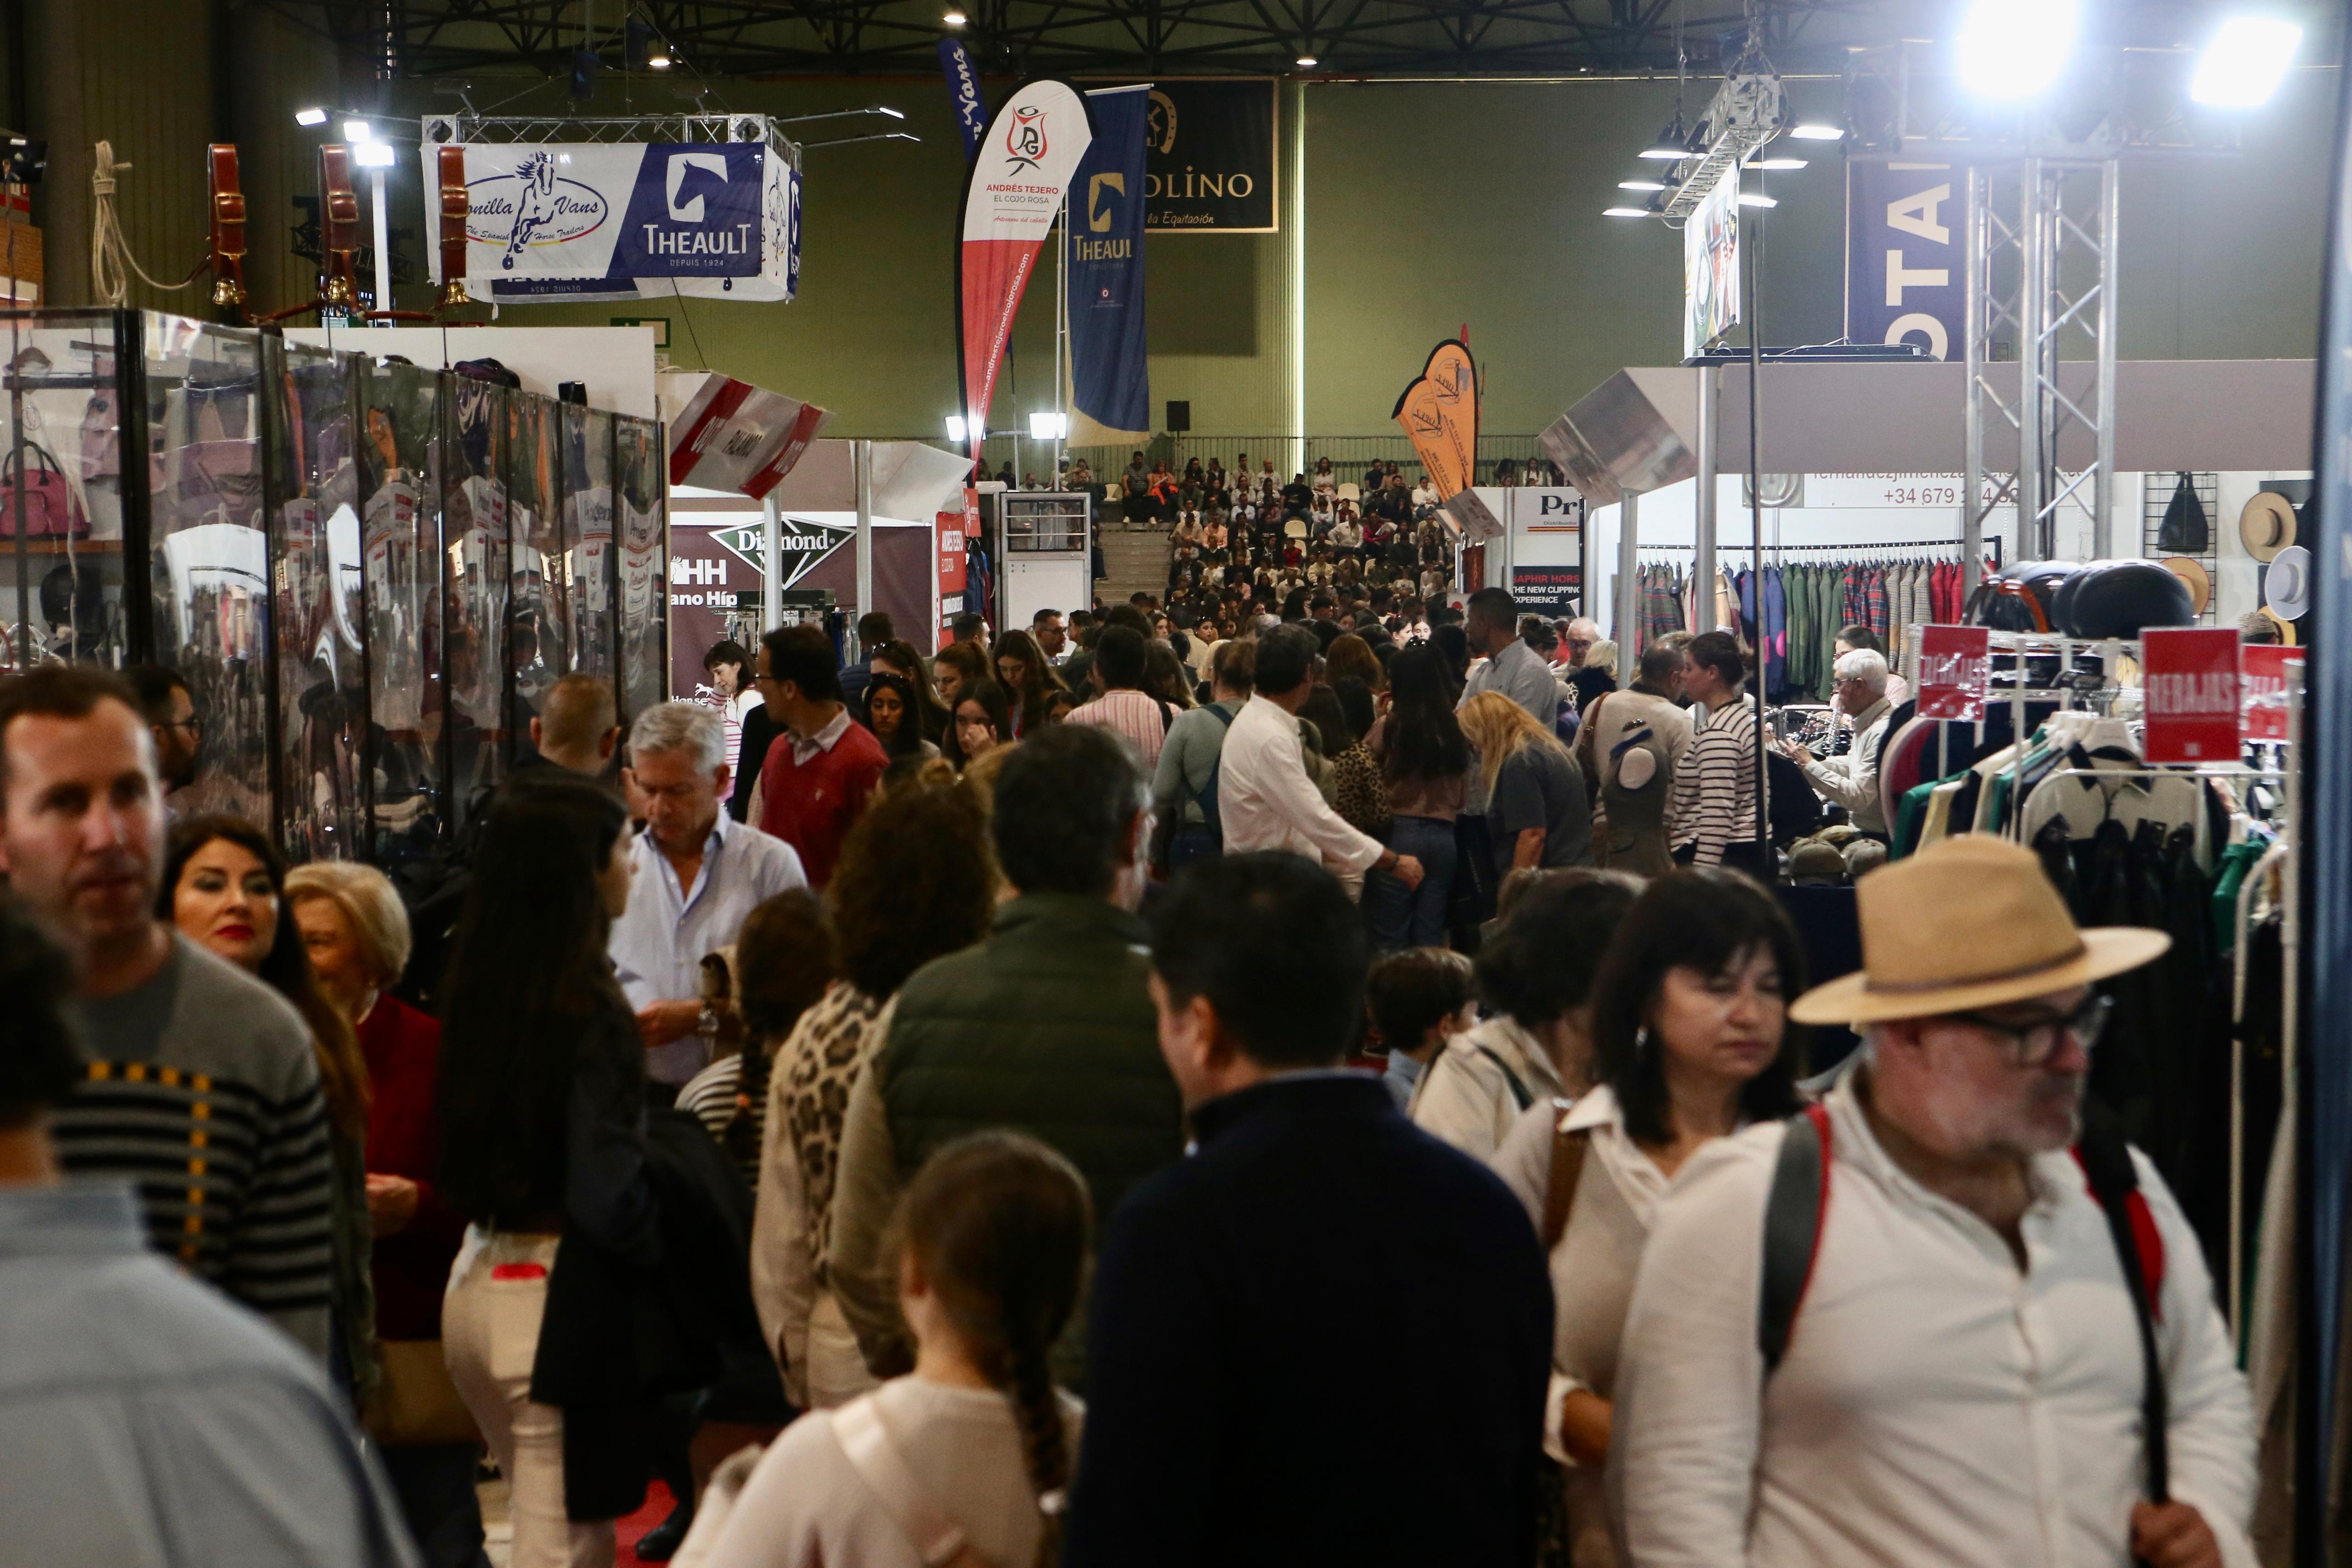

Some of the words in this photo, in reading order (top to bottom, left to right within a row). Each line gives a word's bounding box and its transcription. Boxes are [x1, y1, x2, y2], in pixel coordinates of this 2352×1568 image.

[986, 184, 1022, 192] ANDRÉS
[469, 198, 513, 215] onilla
[554, 196, 599, 214] Vans
[1163, 211, 1215, 226] Equitación
[466, 226, 478, 235] The
[480, 231, 509, 241] Spanish
[557, 225, 584, 237] Trailers
[643, 224, 751, 254] THEAULT
[1073, 235, 1132, 261] THEAUL
[980, 253, 1029, 409] www.andrestejeroelcojorosa.com
[1884, 488, 1916, 503] +34
[1922, 488, 1954, 503] 679
[1540, 496, 1577, 515] Pr
[737, 529, 829, 551] Dimond
[670, 594, 703, 606] ano
[707, 591, 738, 607] Híp
[2149, 672, 2235, 713] REBAJAS
